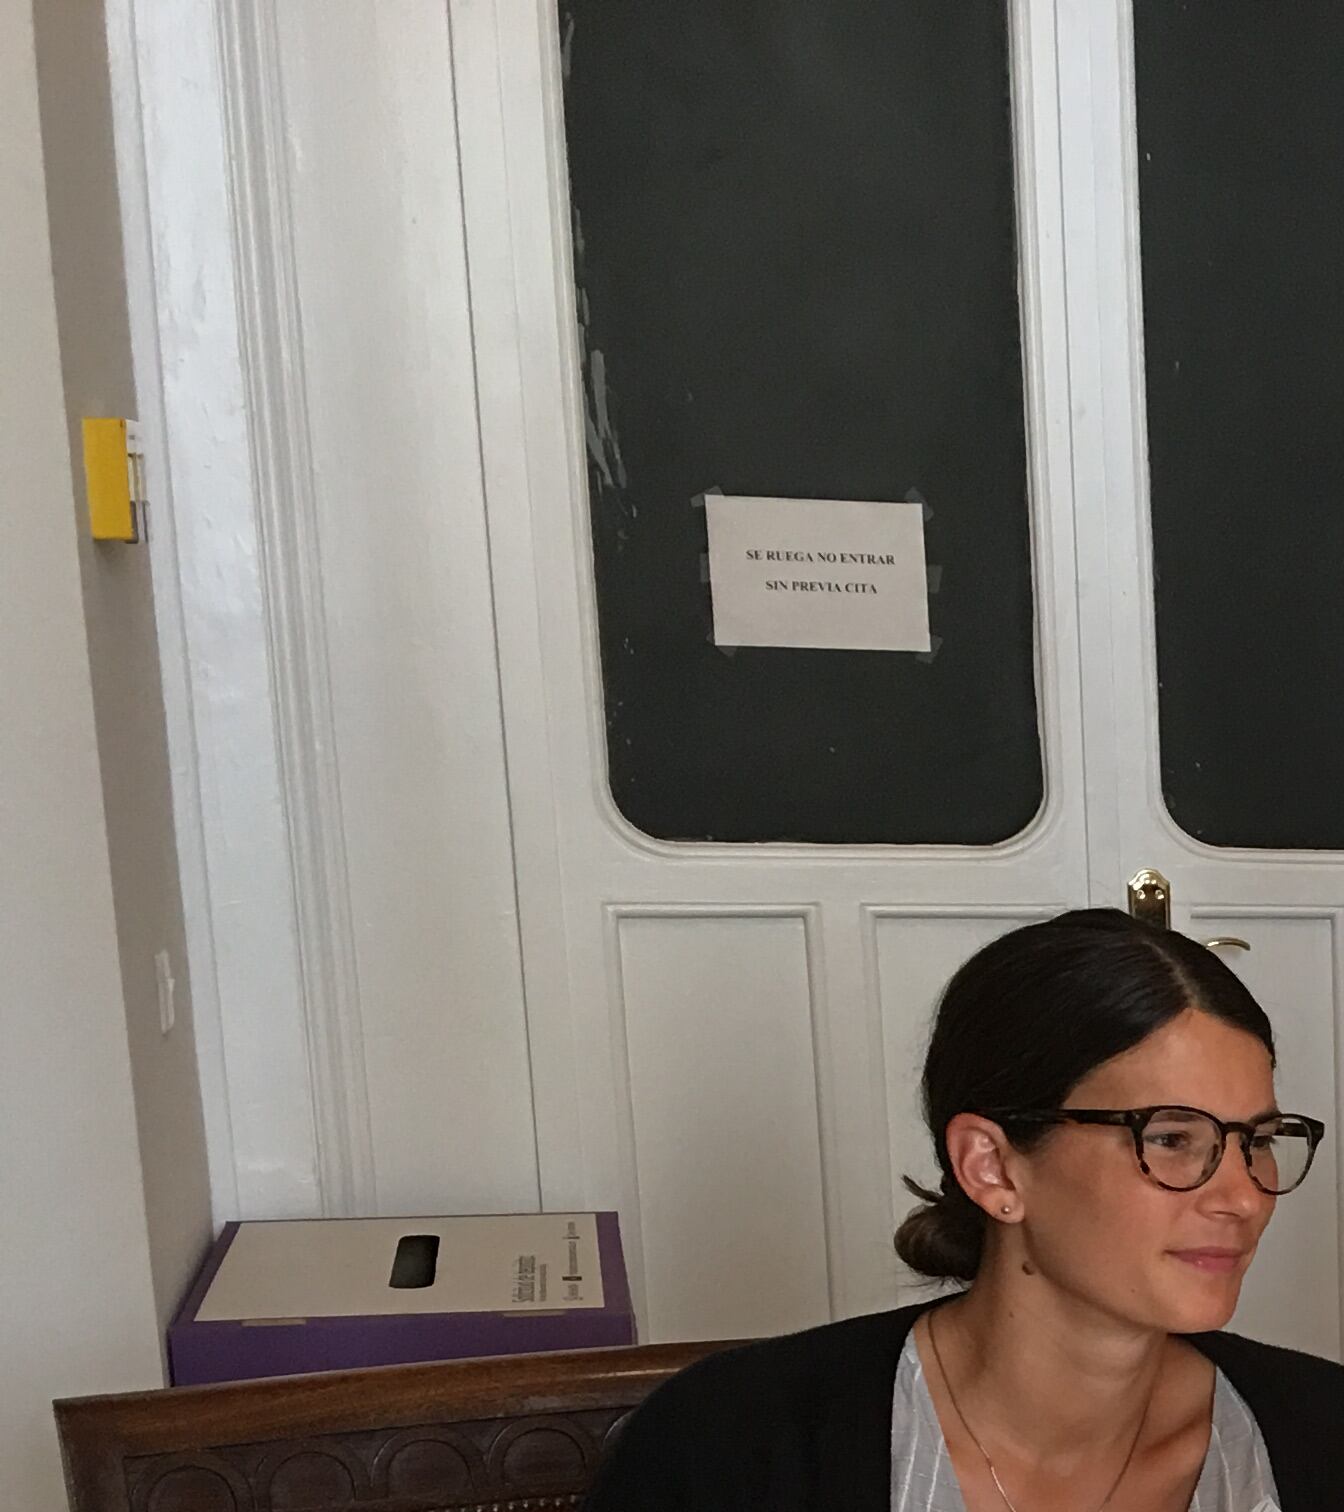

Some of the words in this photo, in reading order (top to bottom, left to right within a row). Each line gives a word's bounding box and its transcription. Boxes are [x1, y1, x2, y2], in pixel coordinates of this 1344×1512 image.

[746, 550, 762, 561] SE
[766, 550, 814, 562] RUEGA
[817, 552, 837, 563] NO
[840, 553, 895, 565] ENTRAR
[765, 580, 788, 590] SIN
[791, 581, 842, 592] PREVIA
[844, 582, 878, 594] CITA
